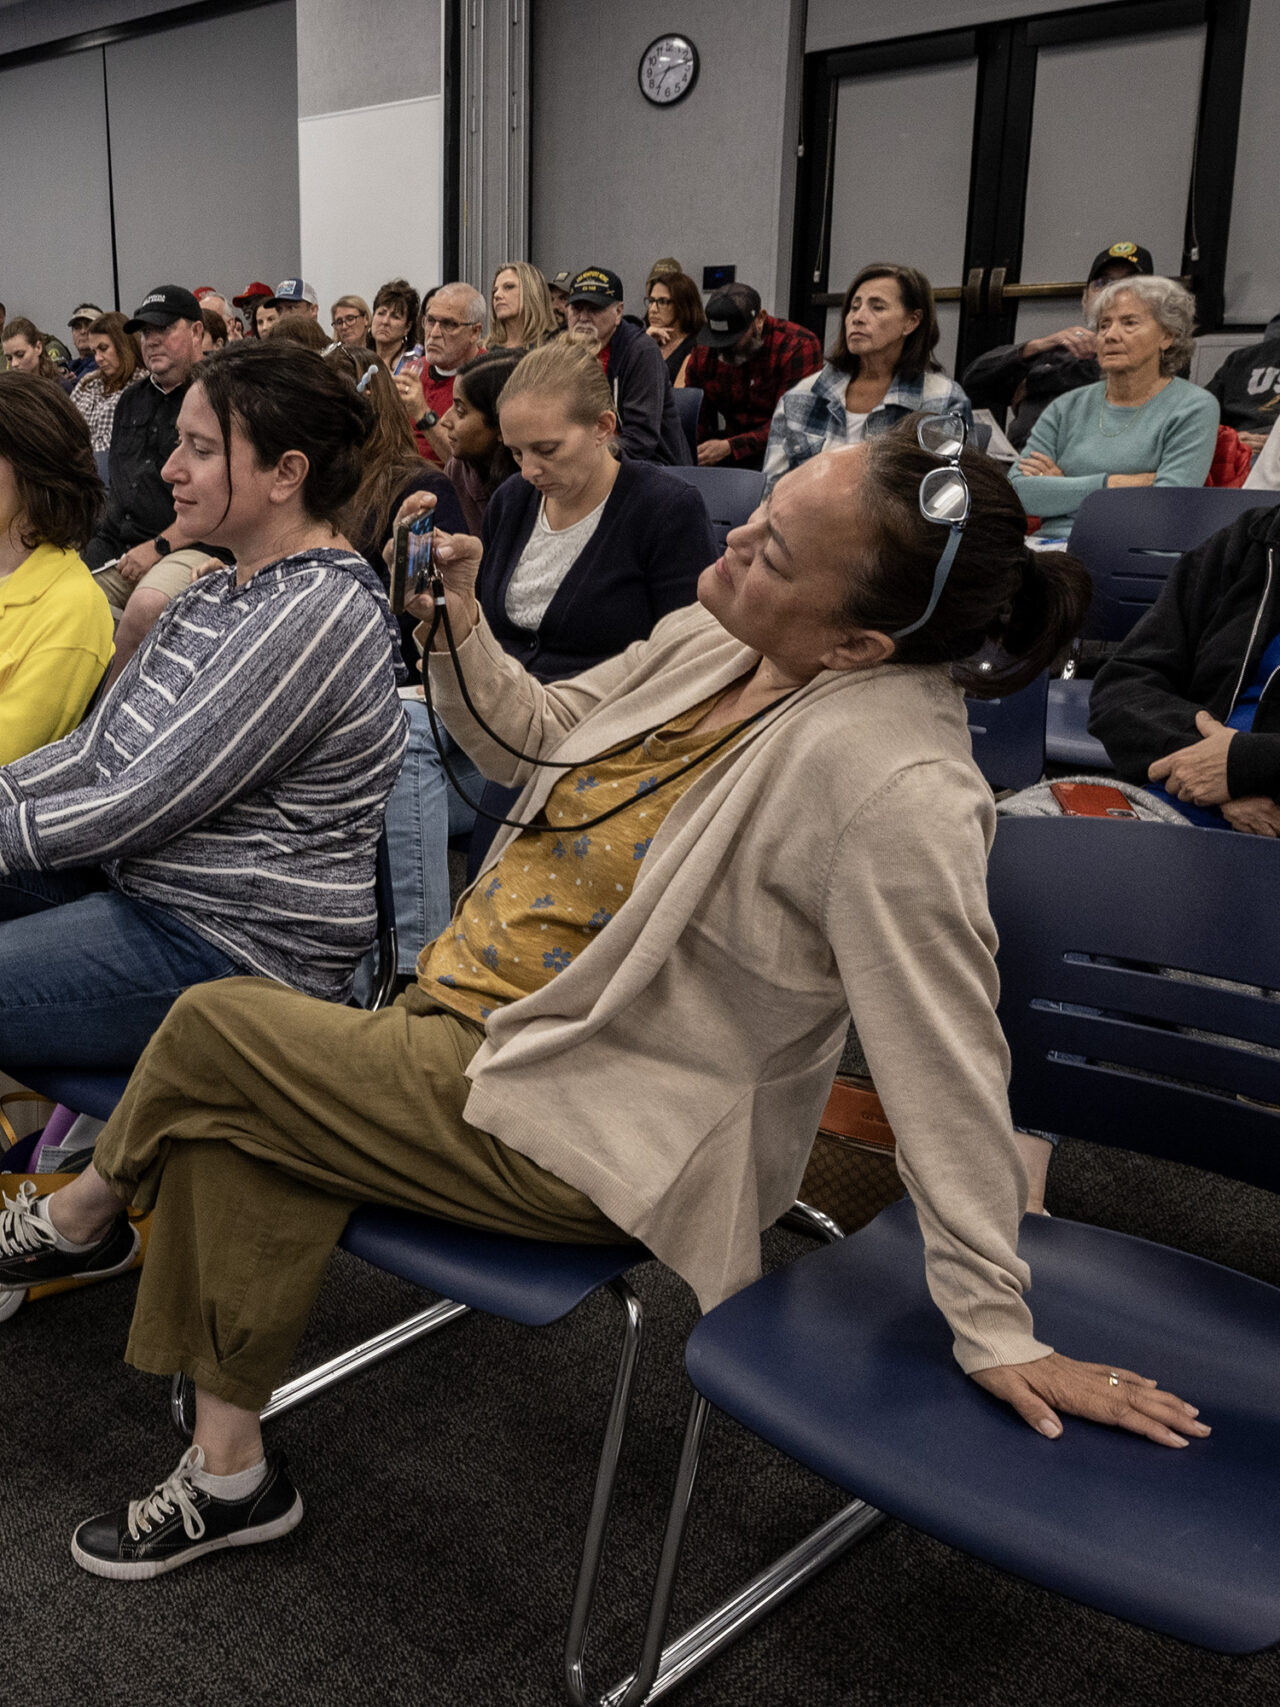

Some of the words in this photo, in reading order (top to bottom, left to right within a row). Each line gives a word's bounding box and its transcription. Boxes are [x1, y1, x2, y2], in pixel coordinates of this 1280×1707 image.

[656, 46, 663, 56] 11
[649, 56, 657, 66] 10
[647, 68, 653, 78] 9
[682, 73, 687, 82] 4
[649, 79, 655, 89] 8
[674, 82, 681, 93] 5
[665, 87, 671, 98] 6
